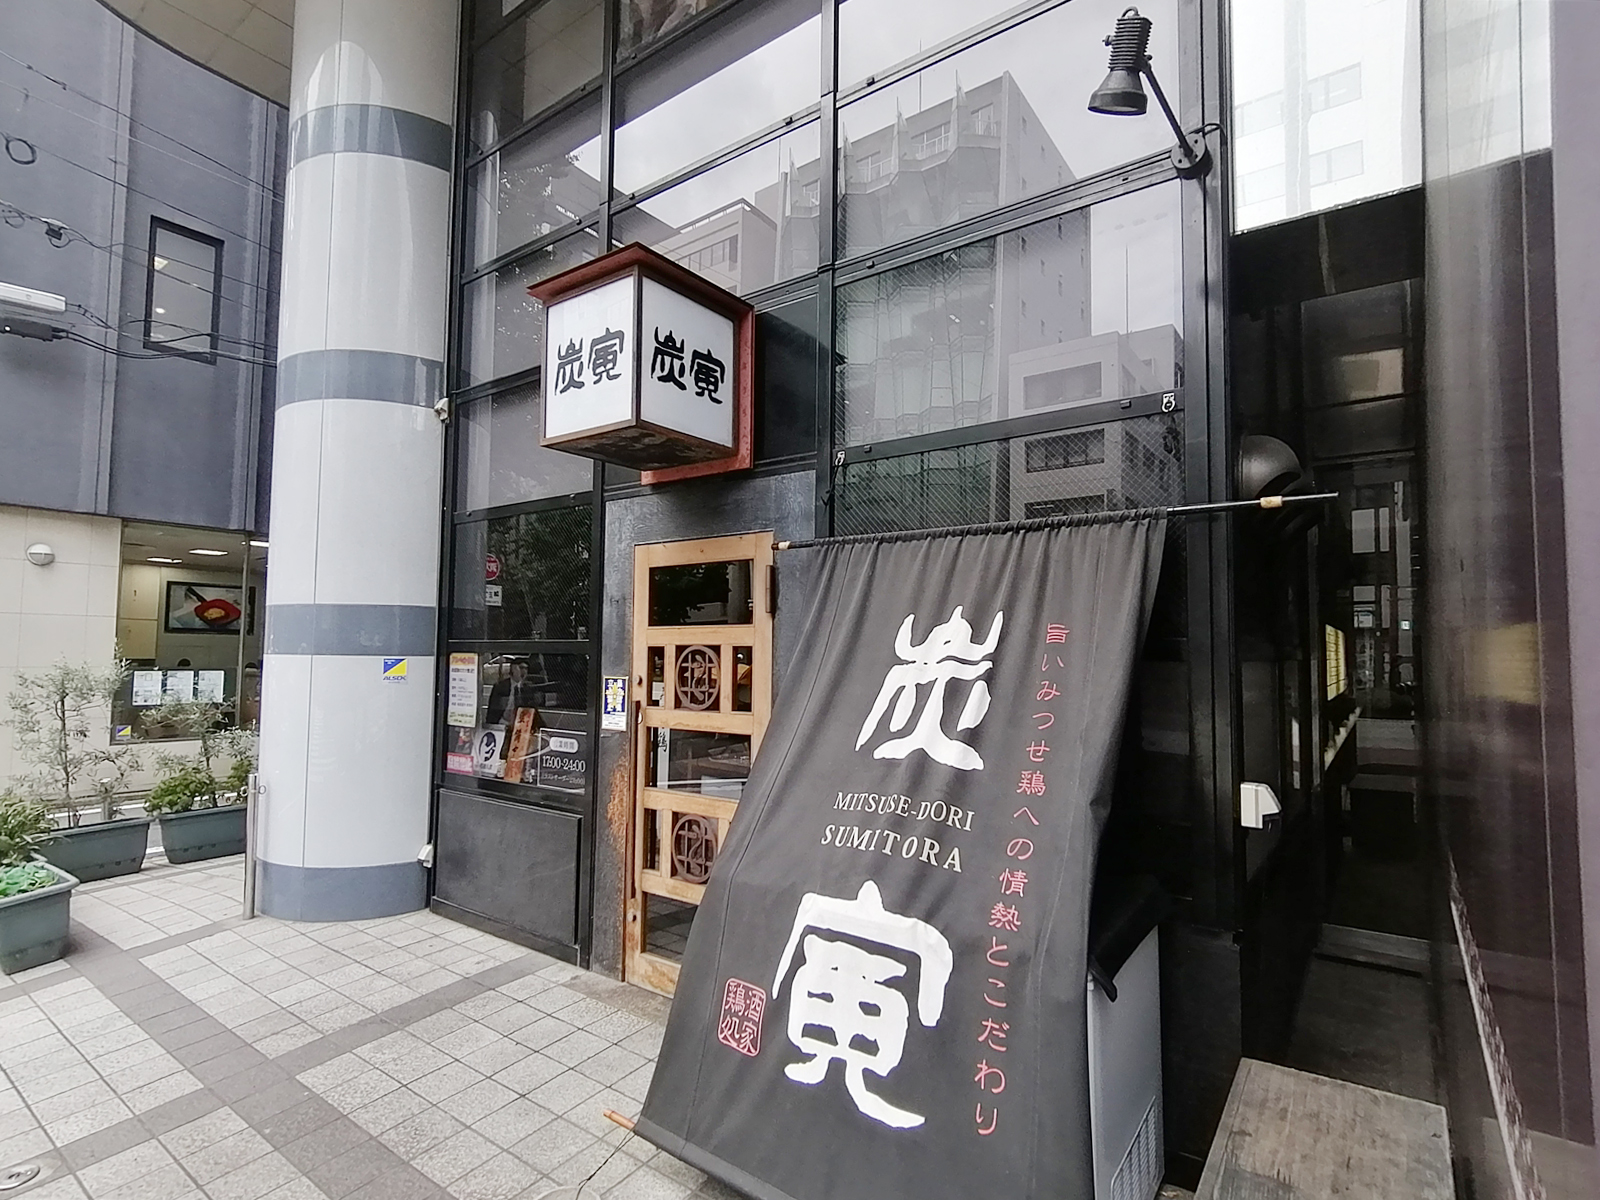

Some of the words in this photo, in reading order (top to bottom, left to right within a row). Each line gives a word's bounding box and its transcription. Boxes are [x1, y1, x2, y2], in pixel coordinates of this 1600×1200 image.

[833, 792, 975, 832] MITSUSE-DORI
[821, 824, 962, 872] SUMITORA
[974, 623, 1070, 1135] 旨いみつせ鶏への情熱とこだわり
